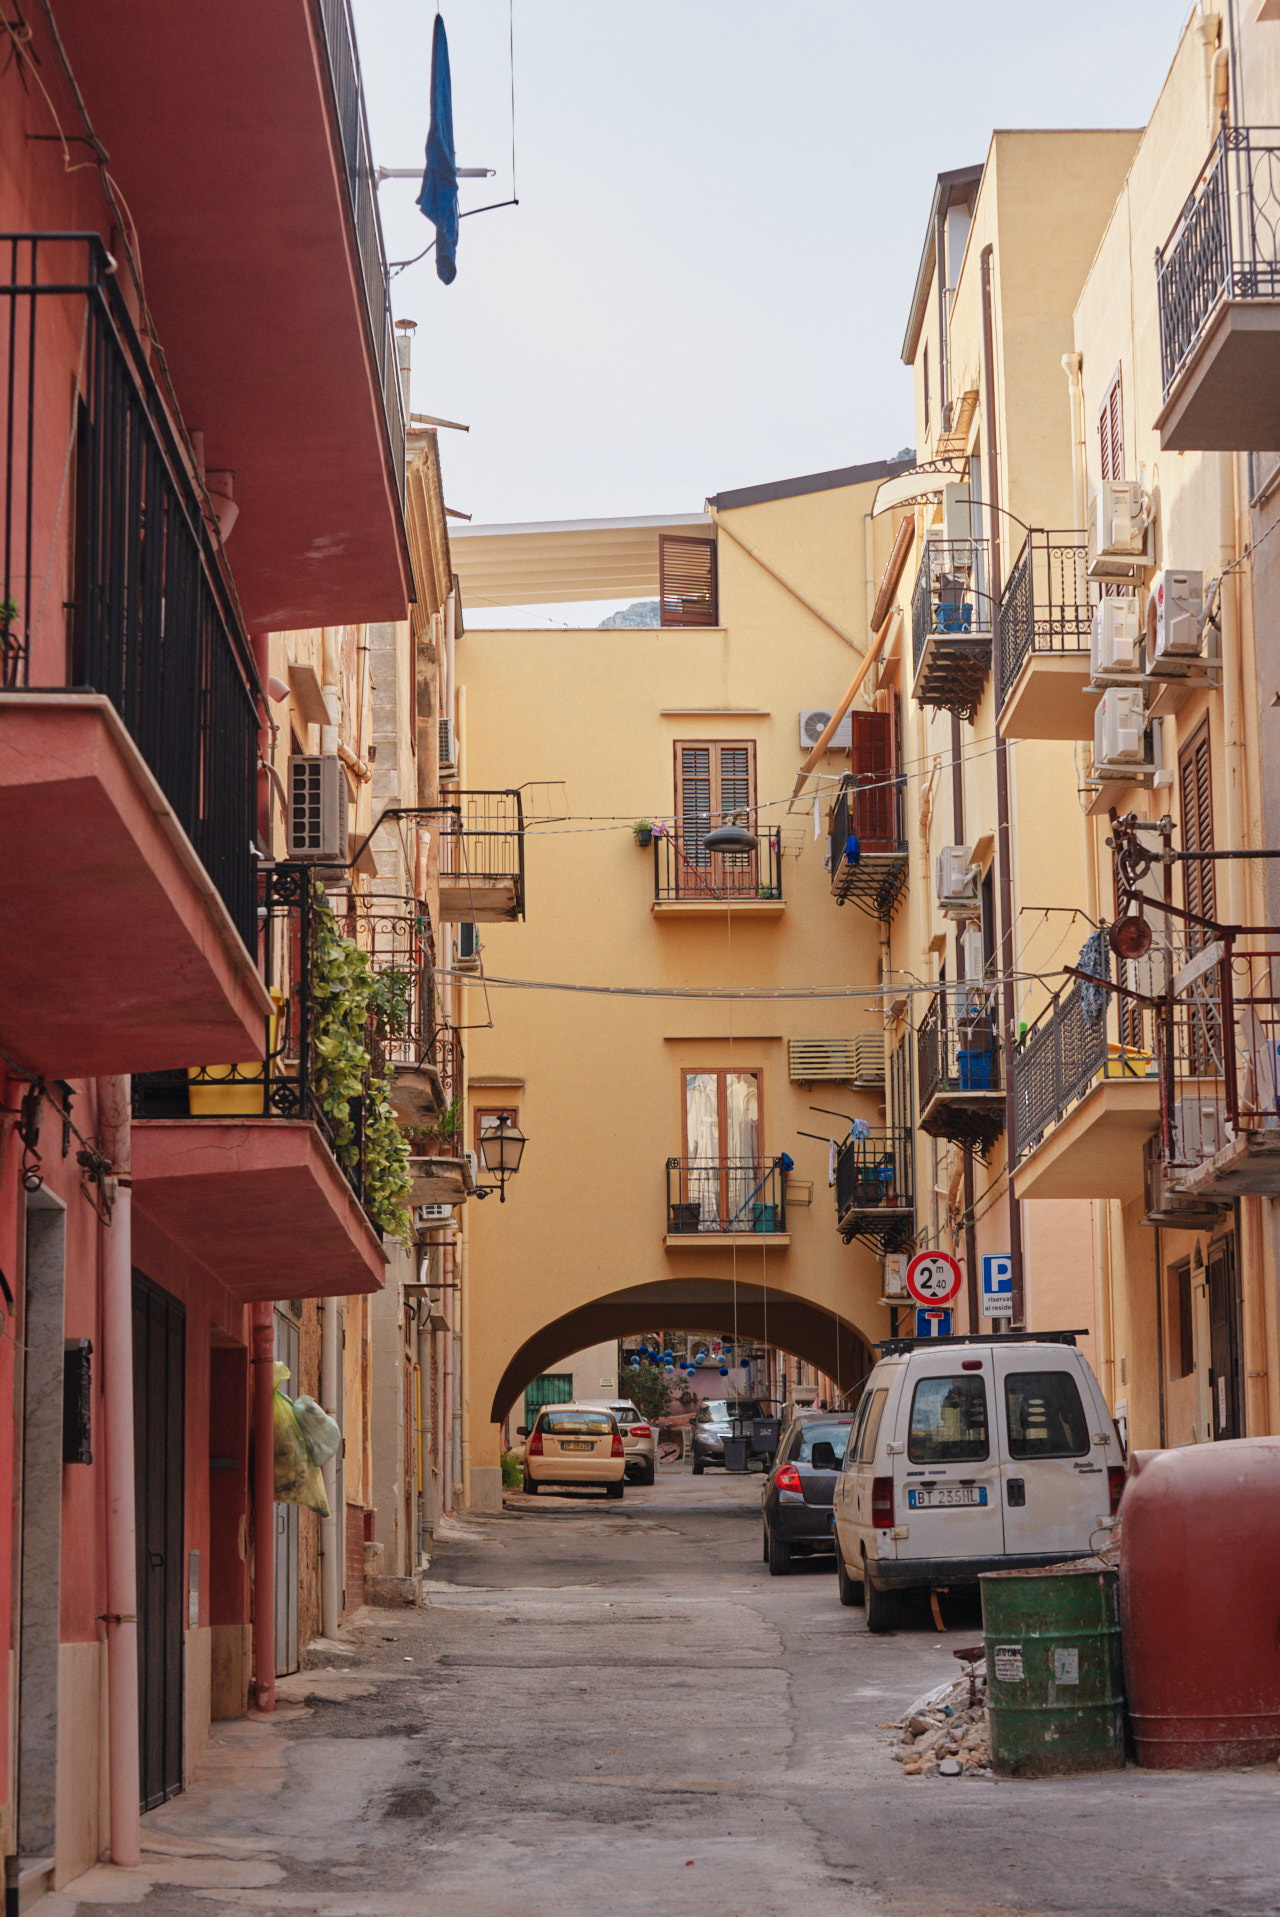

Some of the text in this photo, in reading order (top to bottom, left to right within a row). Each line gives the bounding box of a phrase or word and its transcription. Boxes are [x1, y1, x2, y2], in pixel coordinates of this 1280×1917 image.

[991, 1257, 1012, 1292] P
[917, 1488, 977, 1504] BT 235HL
